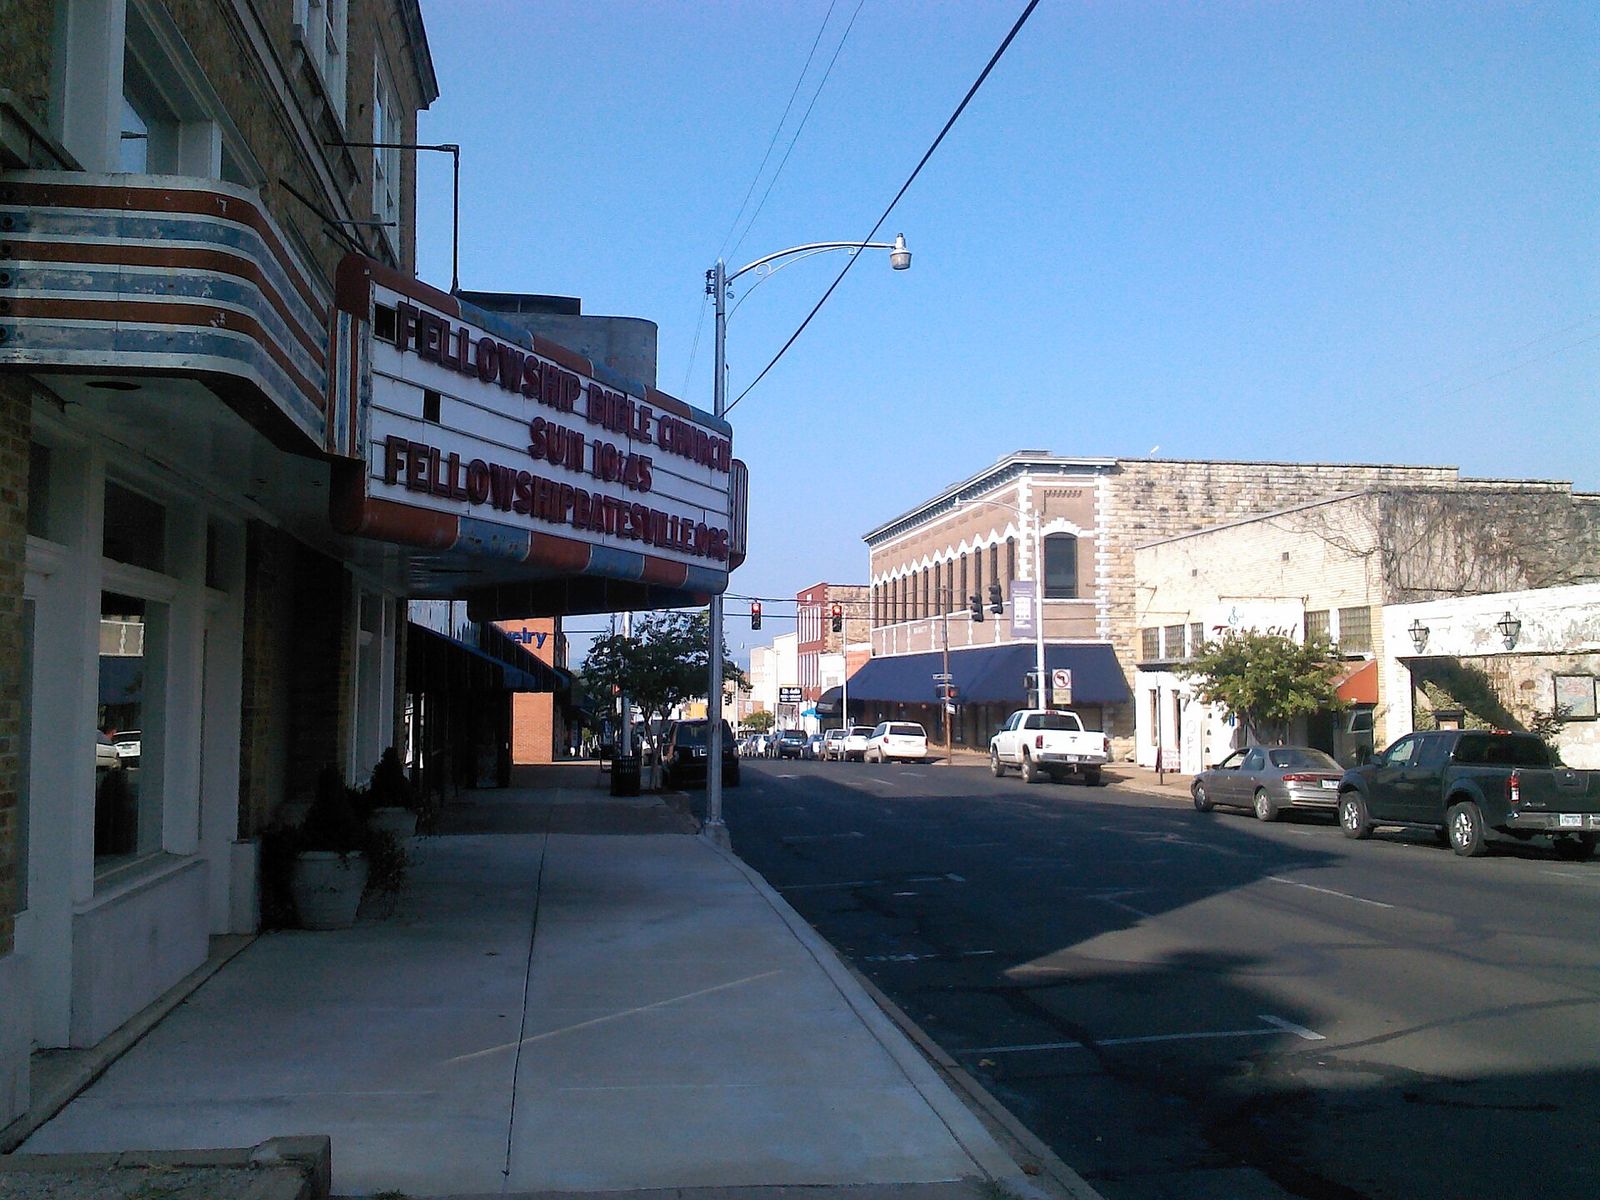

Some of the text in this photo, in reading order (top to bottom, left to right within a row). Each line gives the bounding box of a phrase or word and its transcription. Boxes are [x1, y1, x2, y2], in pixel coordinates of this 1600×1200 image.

[396, 301, 732, 473] FELLOWSHIP BIBLE CHURCH
[528, 416, 653, 493] SUN 10:45
